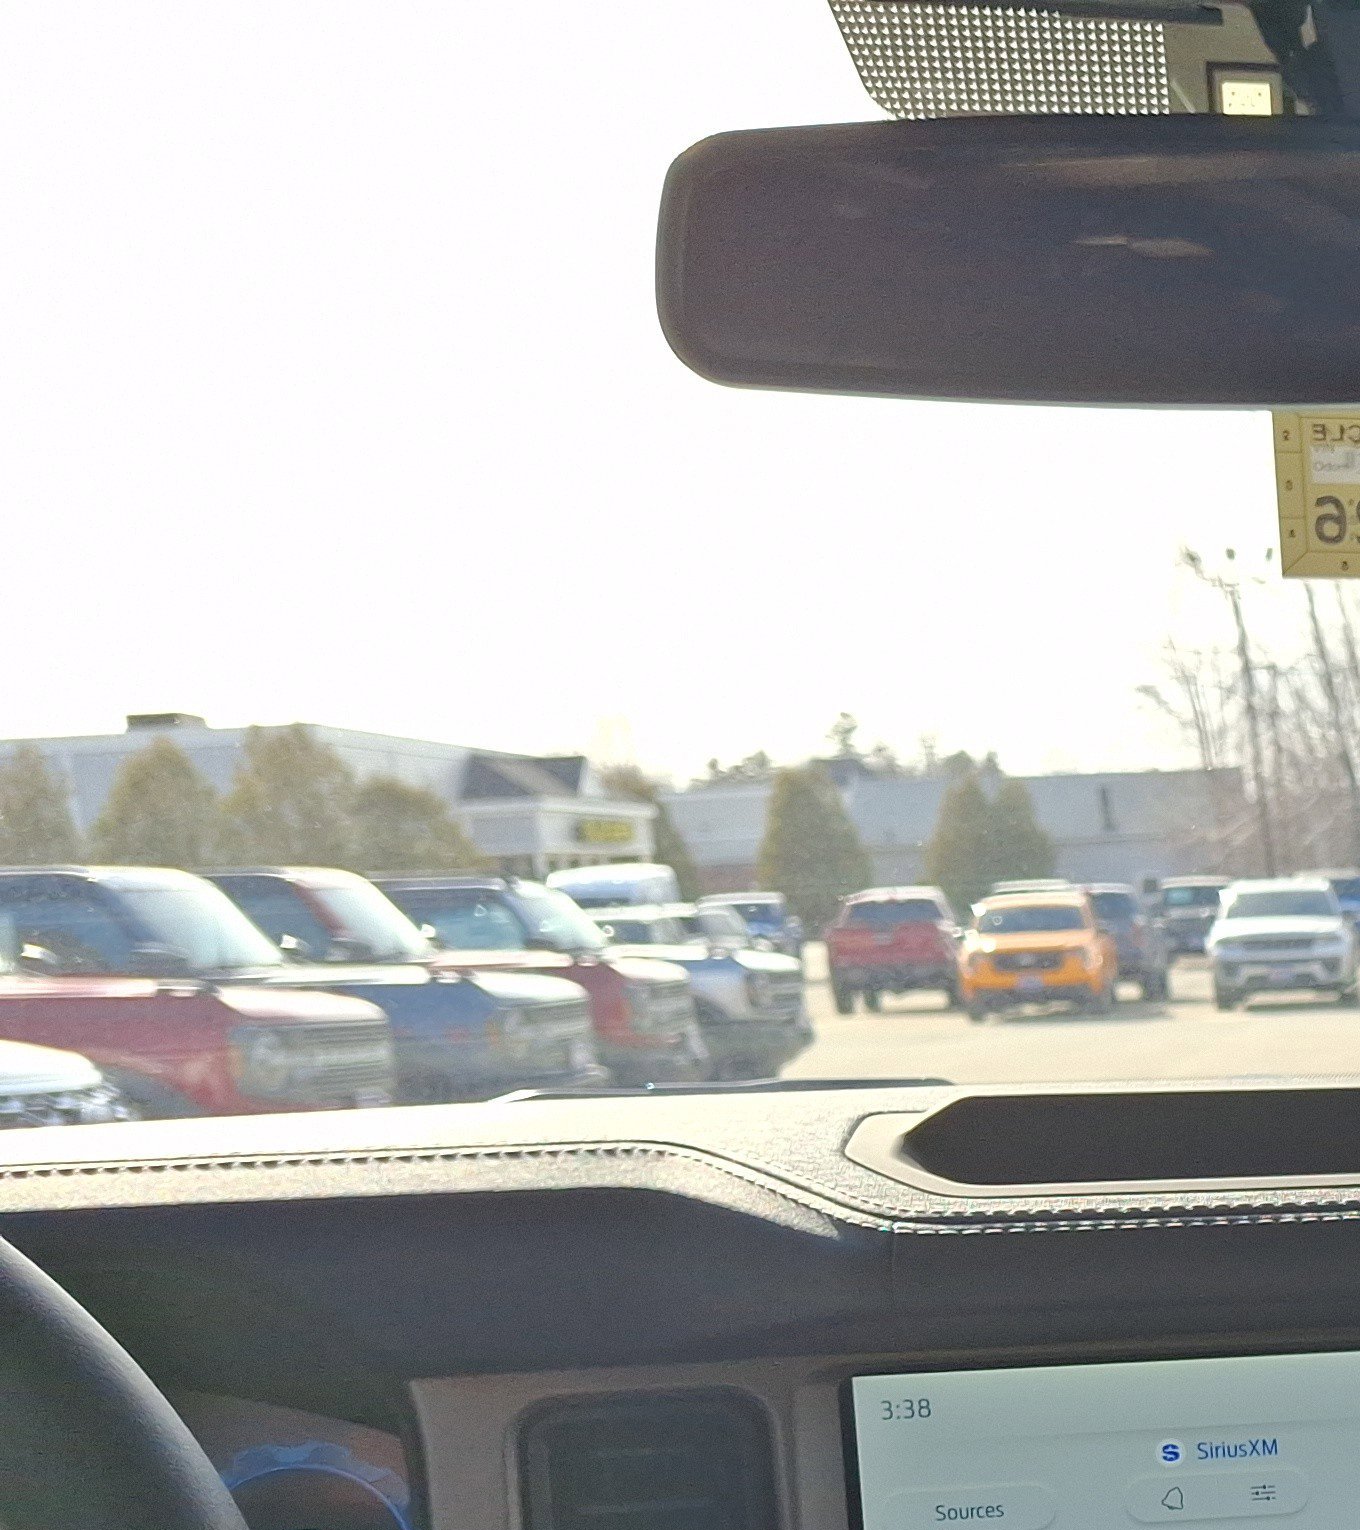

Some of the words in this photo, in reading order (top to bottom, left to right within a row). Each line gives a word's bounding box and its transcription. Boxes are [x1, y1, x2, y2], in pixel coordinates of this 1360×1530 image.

[881, 1398, 932, 1420] 3:38
[1196, 1438, 1279, 1460] SiriusXM
[934, 1502, 1005, 1521] Sources
